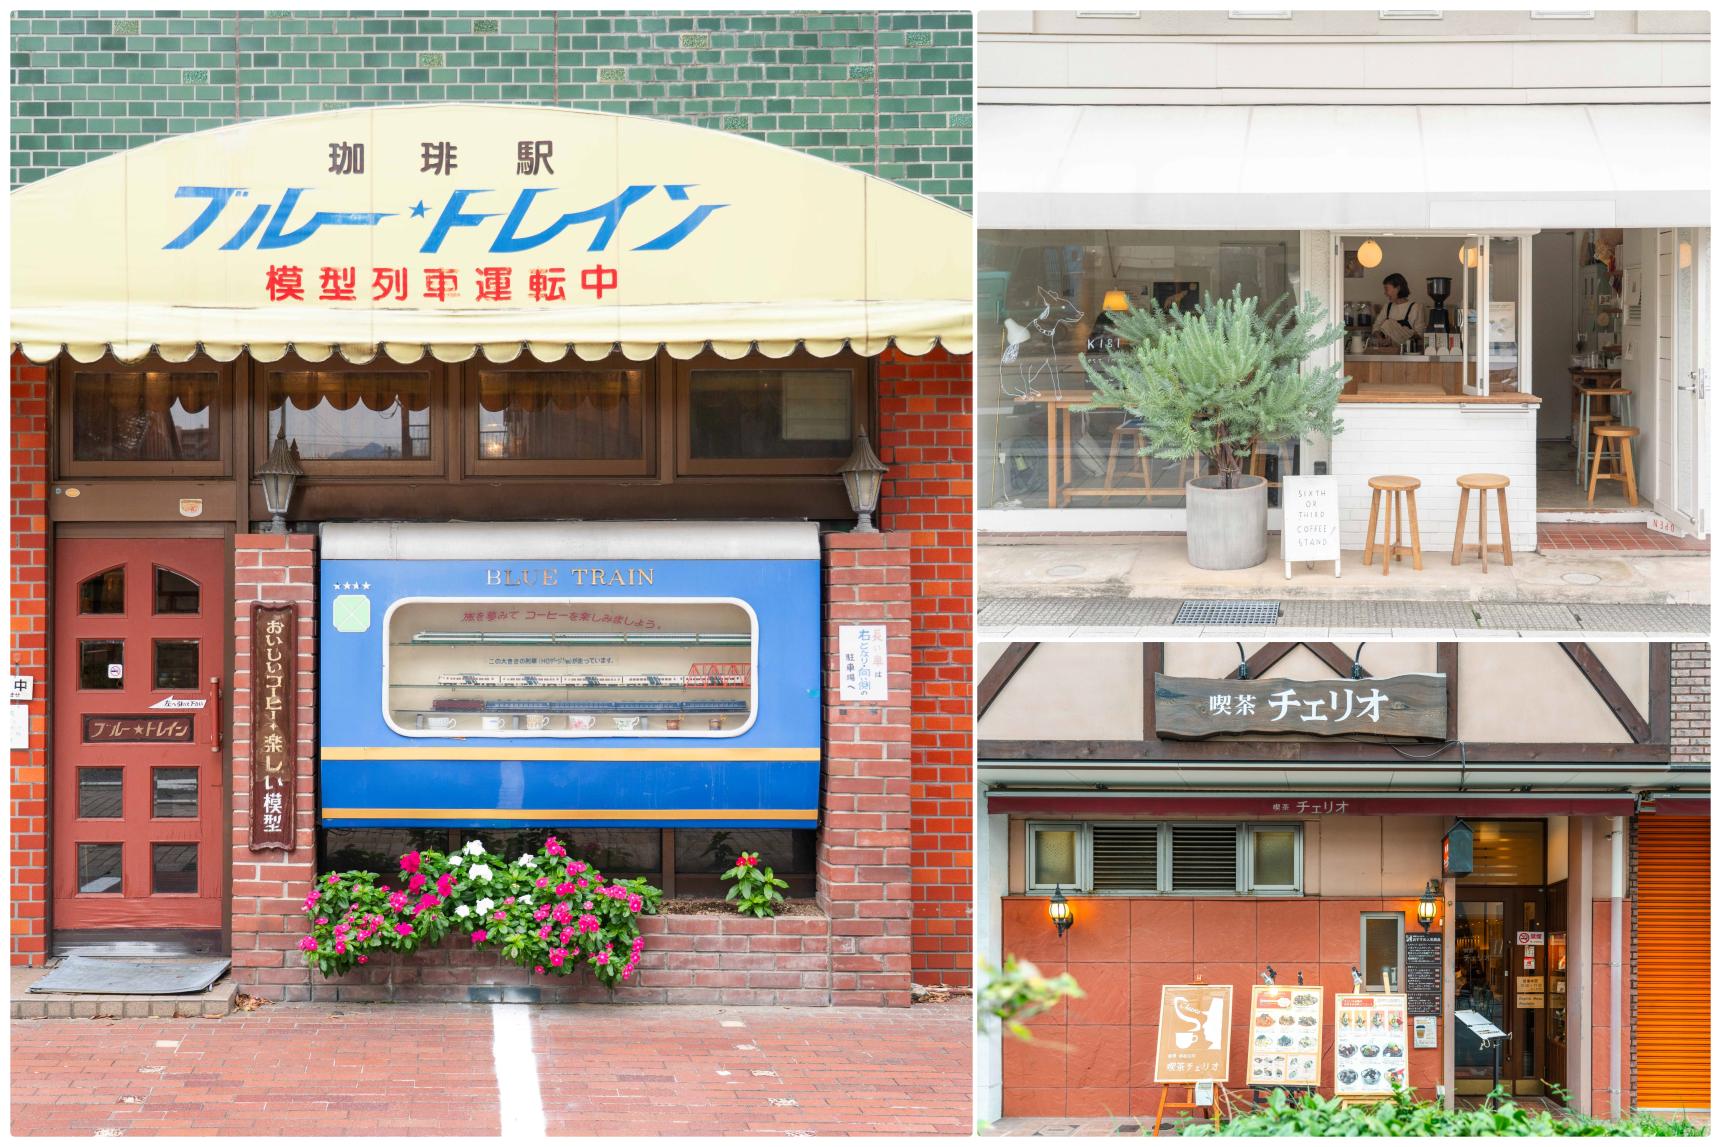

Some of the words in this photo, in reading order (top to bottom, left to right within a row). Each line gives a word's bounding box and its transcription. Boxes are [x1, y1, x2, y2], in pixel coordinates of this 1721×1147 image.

[328, 140, 554, 176] 珈琲駅
[265, 263, 618, 303] 模型列車運転中
[1298, 489, 1327, 498] SIXTH
[1298, 538, 1327, 547] STAND
[487, 568, 558, 587] BLUE
[571, 568, 655, 586] TRAIN
[1209, 694, 1257, 717] 喫茶
[1268, 688, 1389, 722] チェリオ
[1272, 802, 1290, 811] 喫茶
[1296, 800, 1349, 814] チェリオ
